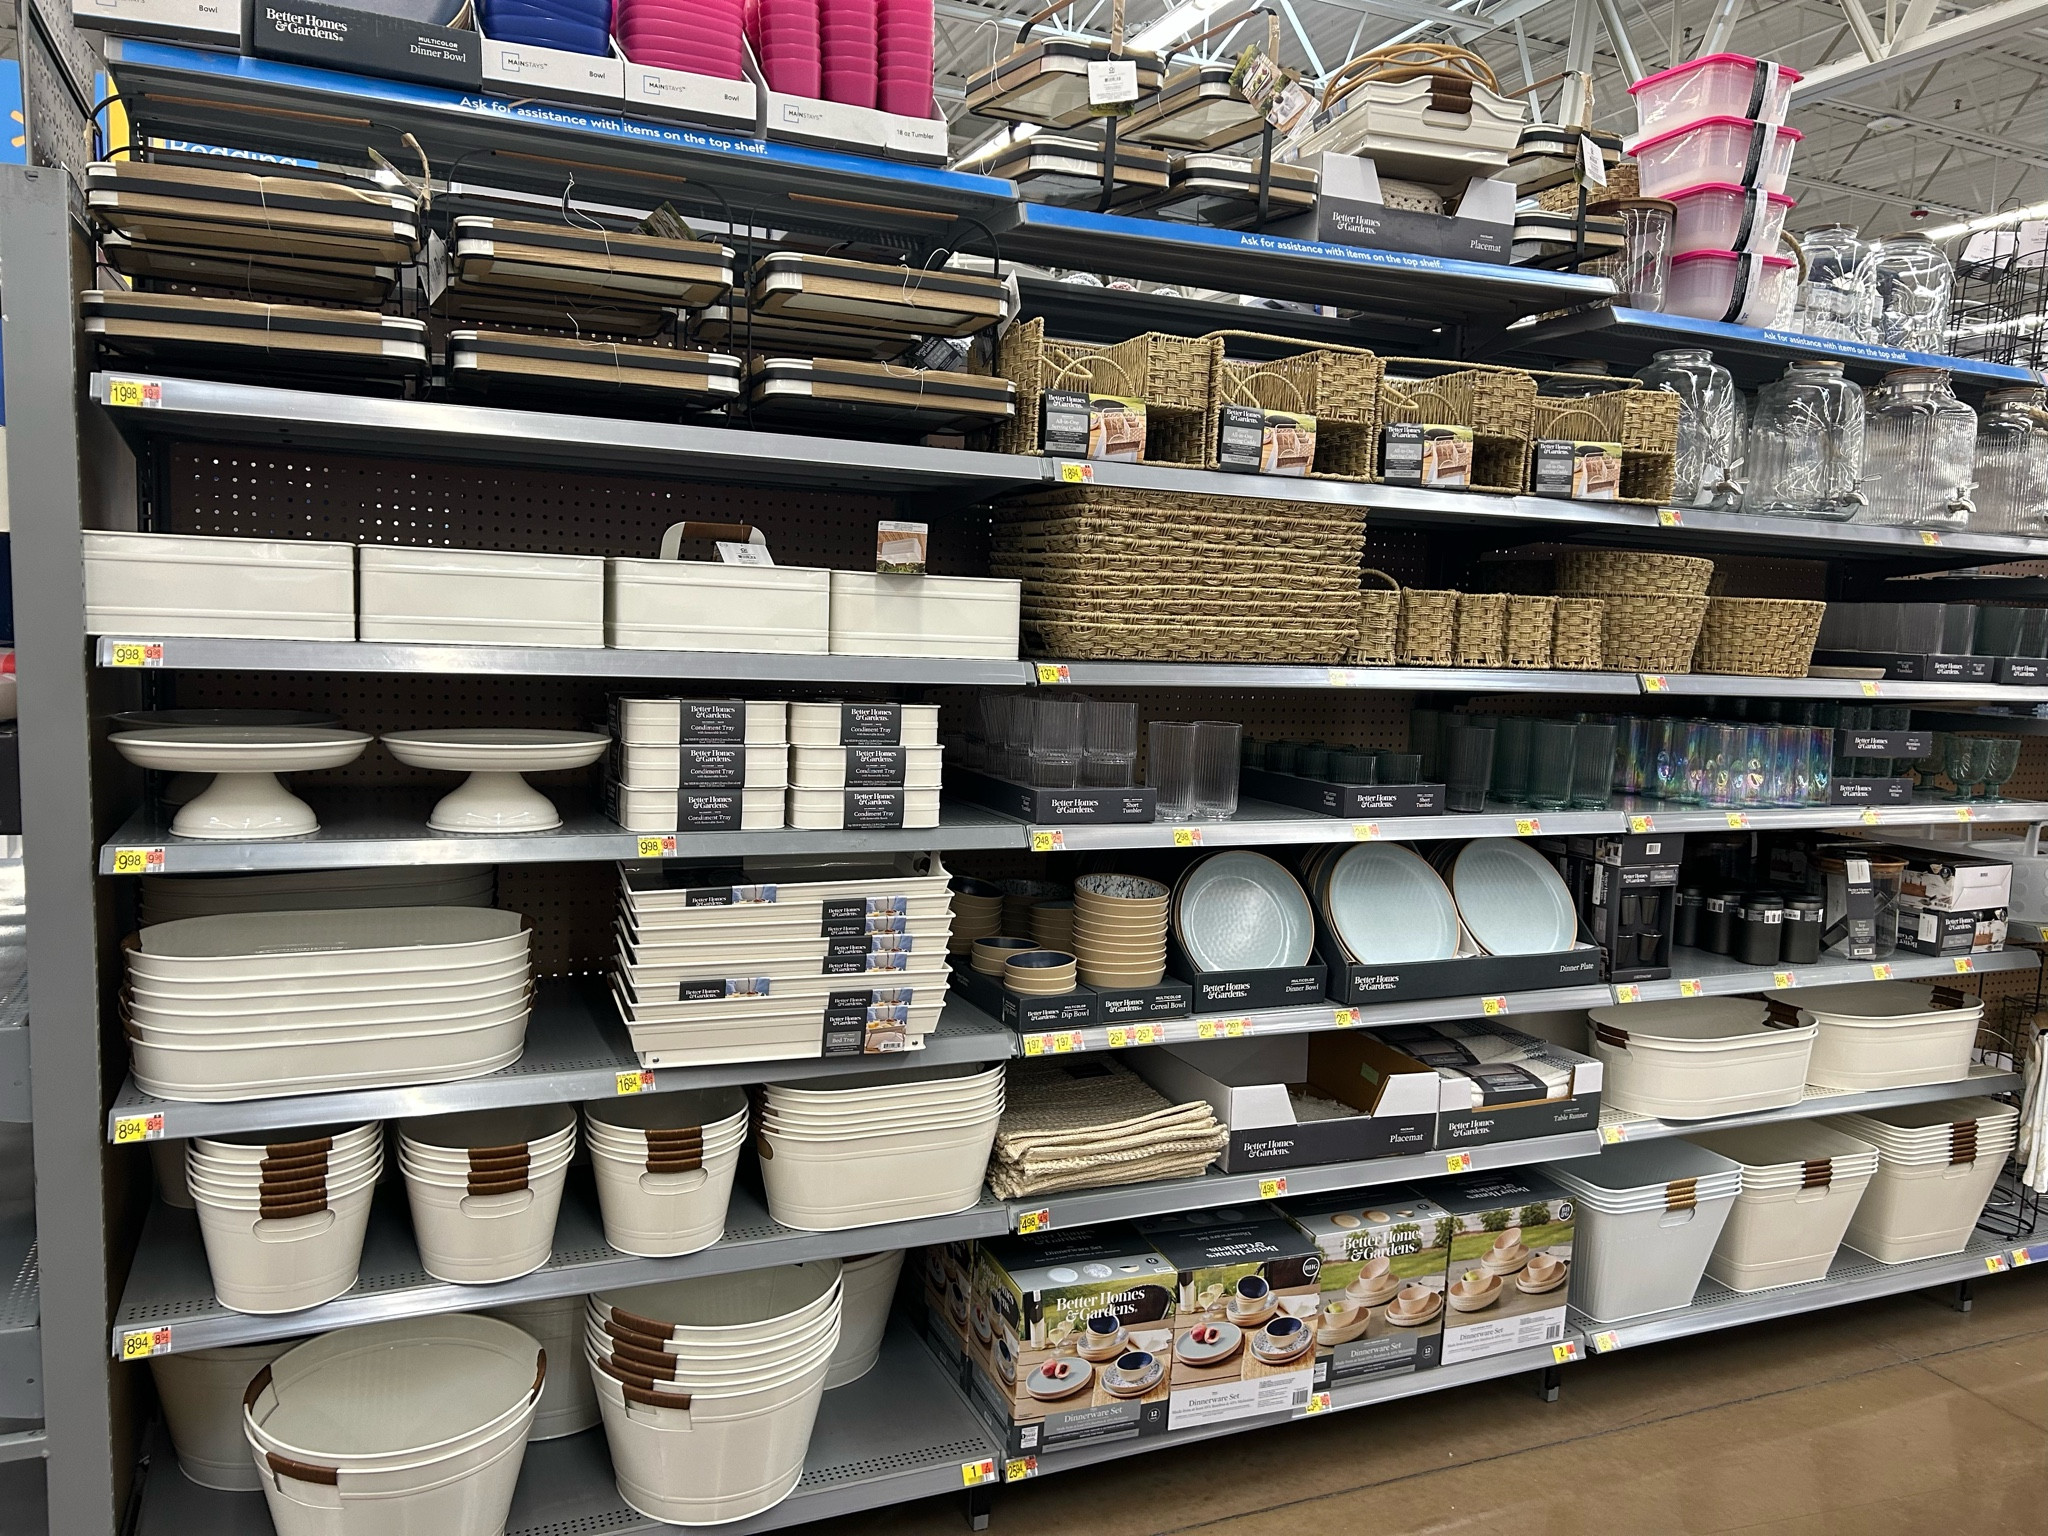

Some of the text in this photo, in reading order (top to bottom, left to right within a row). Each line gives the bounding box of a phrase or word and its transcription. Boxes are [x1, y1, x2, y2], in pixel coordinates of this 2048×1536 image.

[199, 5, 218, 14] Bowl
[266, 8, 348, 32] Better Homes
[418, 36, 458, 48] MULTICOLOR
[410, 45, 466, 62] Dinner Bowl
[589, 70, 606, 79] Bowl
[724, 94, 740, 102] Bowl
[460, 96, 768, 155] Ask for assistance with items on the top shelf.
[911, 132, 934, 140] Tumbler
[1333, 212, 1380, 228] Better Homes
[1470, 239, 1501, 252] Placemat
[1241, 235, 1443, 269] Ask for assistance with items on the top shelf.
[1764, 332, 1776, 340] Ask
[1778, 334, 1788, 342] for
[1789, 337, 1822, 348] assistance
[1824, 341, 1837, 350] with
[1838, 343, 1856, 354] items
[1866, 348, 1878, 358] the
[1878, 350, 1890, 360] top
[116, 648, 140, 662] 998
[852, 708, 870, 716] Better
[688, 796, 708, 804] Better
[1052, 799, 1074, 807] Better
[1357, 794, 1376, 802] Better
[640, 841, 658, 854] 998
[119, 855, 140, 870] 998
[1560, 964, 1580, 972] Dinner
[1354, 975, 1399, 984] Better Homes
[1203, 984, 1224, 993] Better
[1106, 1000, 1123, 1008] Better
[1150, 1001, 1186, 1010] Cereal Bowl
[1061, 1009, 1090, 1019] Dip Bowl
[1336, 1014, 1348, 1026] 297
[1110, 1032, 1122, 1045] 257
[1138, 1029, 1150, 1041] 257
[1027, 1040, 1040, 1051] 197
[1056, 1036, 1068, 1048] 197
[1554, 1111, 1588, 1122] Table Runner
[119, 1123, 140, 1139] 894
[1448, 1120, 1495, 1131] Better Homes
[1390, 1133, 1423, 1143] Placemat
[1244, 1139, 1294, 1151] Better Homes
[1262, 1182, 1275, 1195] 498
[1021, 1217, 1036, 1231] 498
[1342, 1228, 1424, 1250] Better Homes
[1056, 1289, 1146, 1312] Better Homes
[1460, 1330, 1494, 1341] Dinnerware
[127, 1337, 148, 1354] 894
[1350, 1345, 1390, 1358] Dinnerware
[1188, 1395, 1228, 1406] Dinnerware
[1064, 1407, 1122, 1423] Dinnerware Set
[971, 1465, 976, 1477] 1
